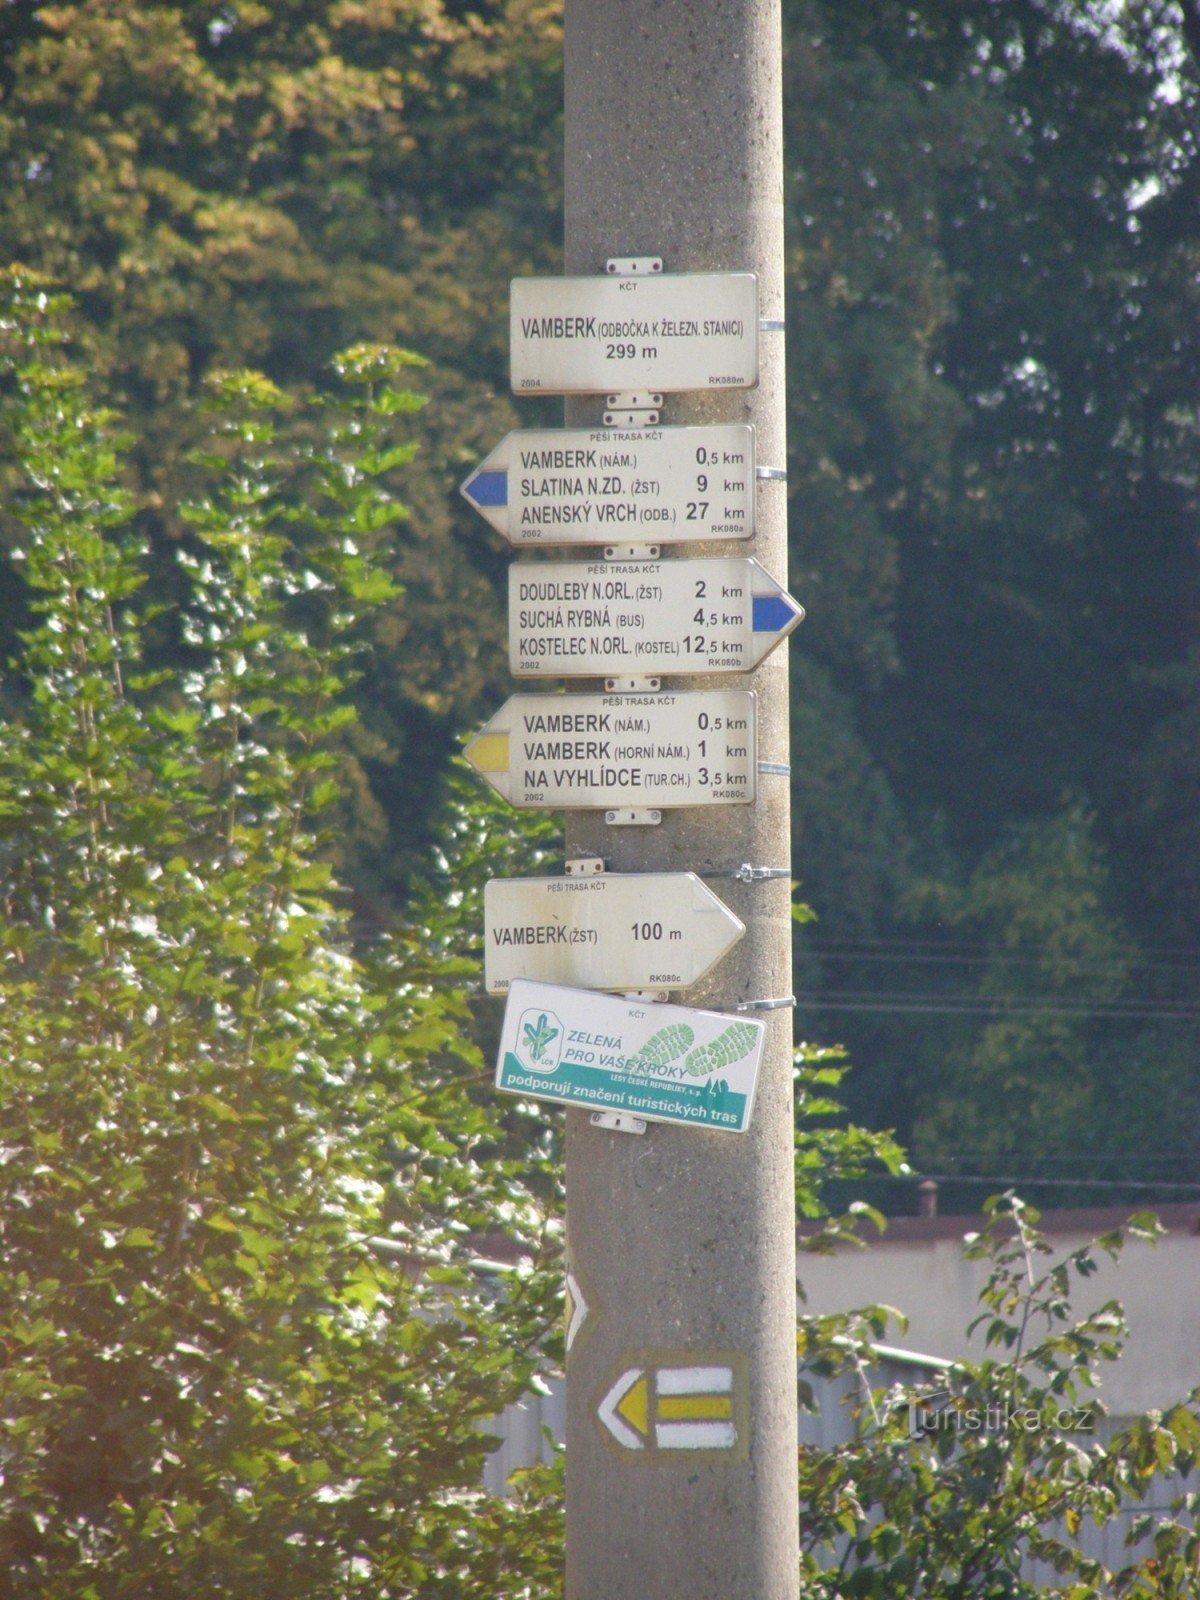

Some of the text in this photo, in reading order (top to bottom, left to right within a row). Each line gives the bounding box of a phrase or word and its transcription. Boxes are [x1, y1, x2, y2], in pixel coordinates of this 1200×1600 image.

[619, 282, 637, 291] KČT
[522, 317, 743, 341] VAMBERK (ODBOČKA K ŽELEZN. STANICI)
[606, 344, 657, 359] 299 m
[521, 379, 540, 387] 2004
[709, 376, 744, 384] RK080m
[590, 432, 662, 442] PĚŠÍ TRASA KČT
[521, 450, 637, 470] VAMBERK (NÁM.)
[696, 447, 743, 466] 0,5 km
[522, 477, 660, 496] SLATINA N.ZD. (ŽST)
[697, 475, 744, 492] 9 km
[522, 501, 676, 524] ANENSKÝ VRCH (ODB.)
[686, 503, 744, 520] 27 km
[711, 525, 744, 533] RK080a
[588, 564, 660, 574] PĚŠÍ TRASA KČT
[520, 582, 662, 601] DOUDLEBY N.ORL. (ŽST)
[695, 581, 742, 598] 2 km
[520, 605, 644, 628] SUCHÁ RYBNÁ (BUS)
[694, 608, 743, 627] 4,5 km
[520, 636, 679, 657] KOSTELEC N.ORL. (KOSTEL)
[683, 636, 743, 655] 12,5 km
[708, 658, 741, 666] RK080b
[603, 697, 675, 706] PĚŠÍ TRASA KČT
[524, 714, 650, 734] VAMBERK (NÁM.)
[698, 712, 746, 732] 0,5 km
[524, 742, 690, 761] VAMBERK (HORNÍ NÁM.)
[698, 740, 746, 757] 1 km
[524, 765, 691, 788] NA VYHLÍDCE (TUR.CH.)
[698, 768, 746, 788] 3,5 km
[524, 793, 544, 801] 2002
[713, 790, 745, 798] RK080c
[547, 882, 605, 892] PĚŠÍ TRASA KČT
[493, 925, 597, 946] VAMBERK (ŽST)
[631, 923, 681, 940] 100 m
[650, 975, 680, 983] RK080c
[628, 1010, 645, 1019] KČT
[567, 1030, 622, 1050] ZELENÁ
[564, 1048, 688, 1080] PRO VAŠE KROKY
[610, 1074, 628, 1083] LESY
[627, 1075, 649, 1088] ČESKÉ
[507, 1073, 737, 1124] podporují značení turistických tras
